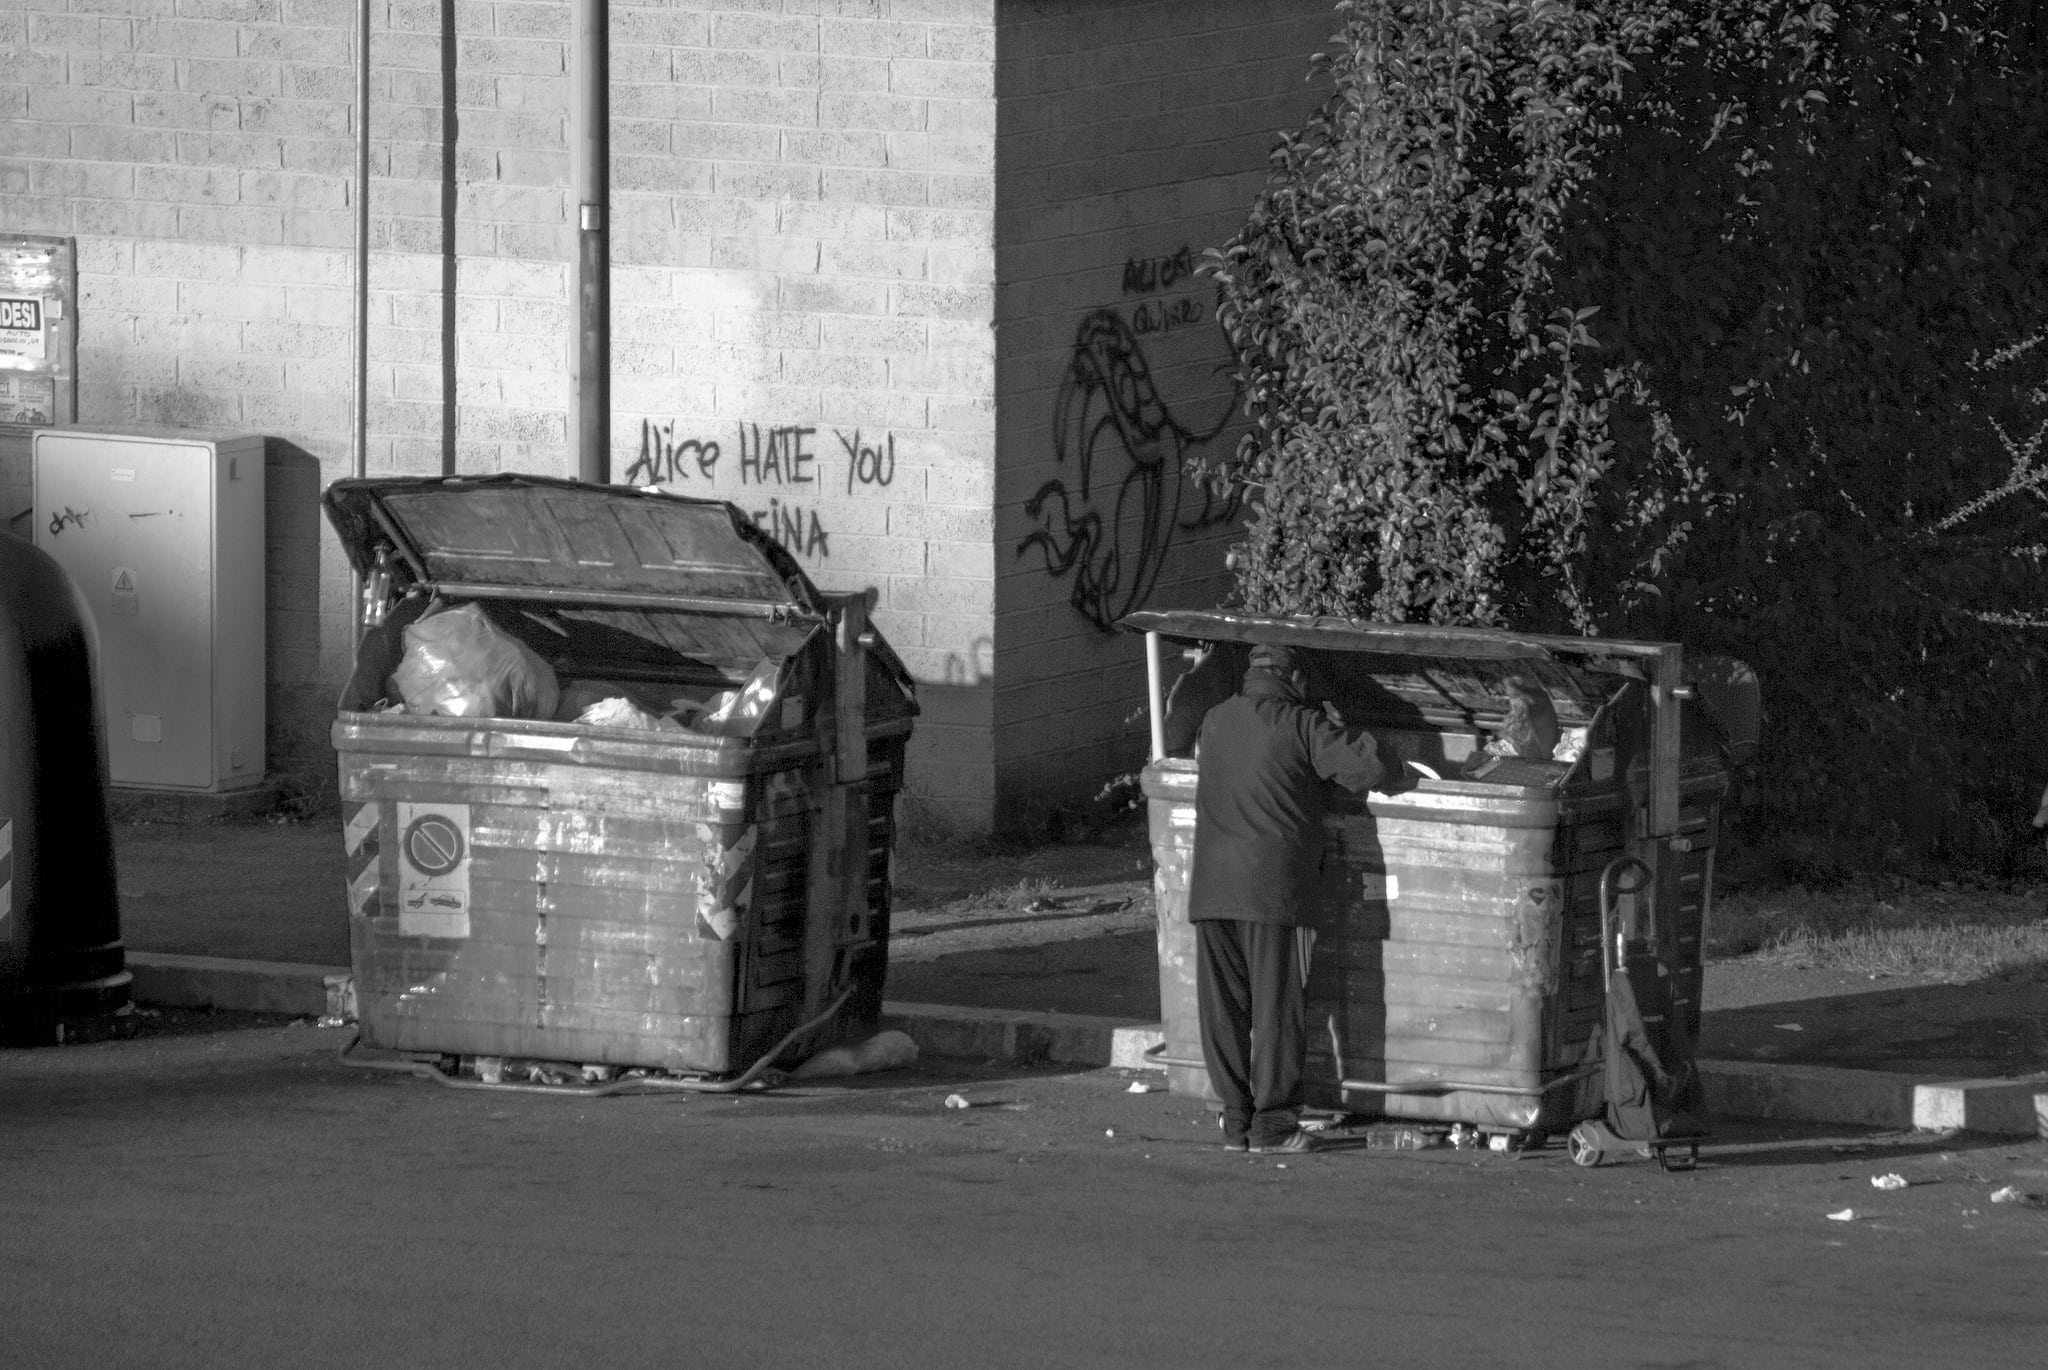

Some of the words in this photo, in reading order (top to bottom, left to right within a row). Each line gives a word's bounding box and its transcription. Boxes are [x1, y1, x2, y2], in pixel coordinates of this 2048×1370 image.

[0, 301, 36, 328] DESI
[739, 420, 817, 485] HATE
[833, 428, 895, 495] YOU
